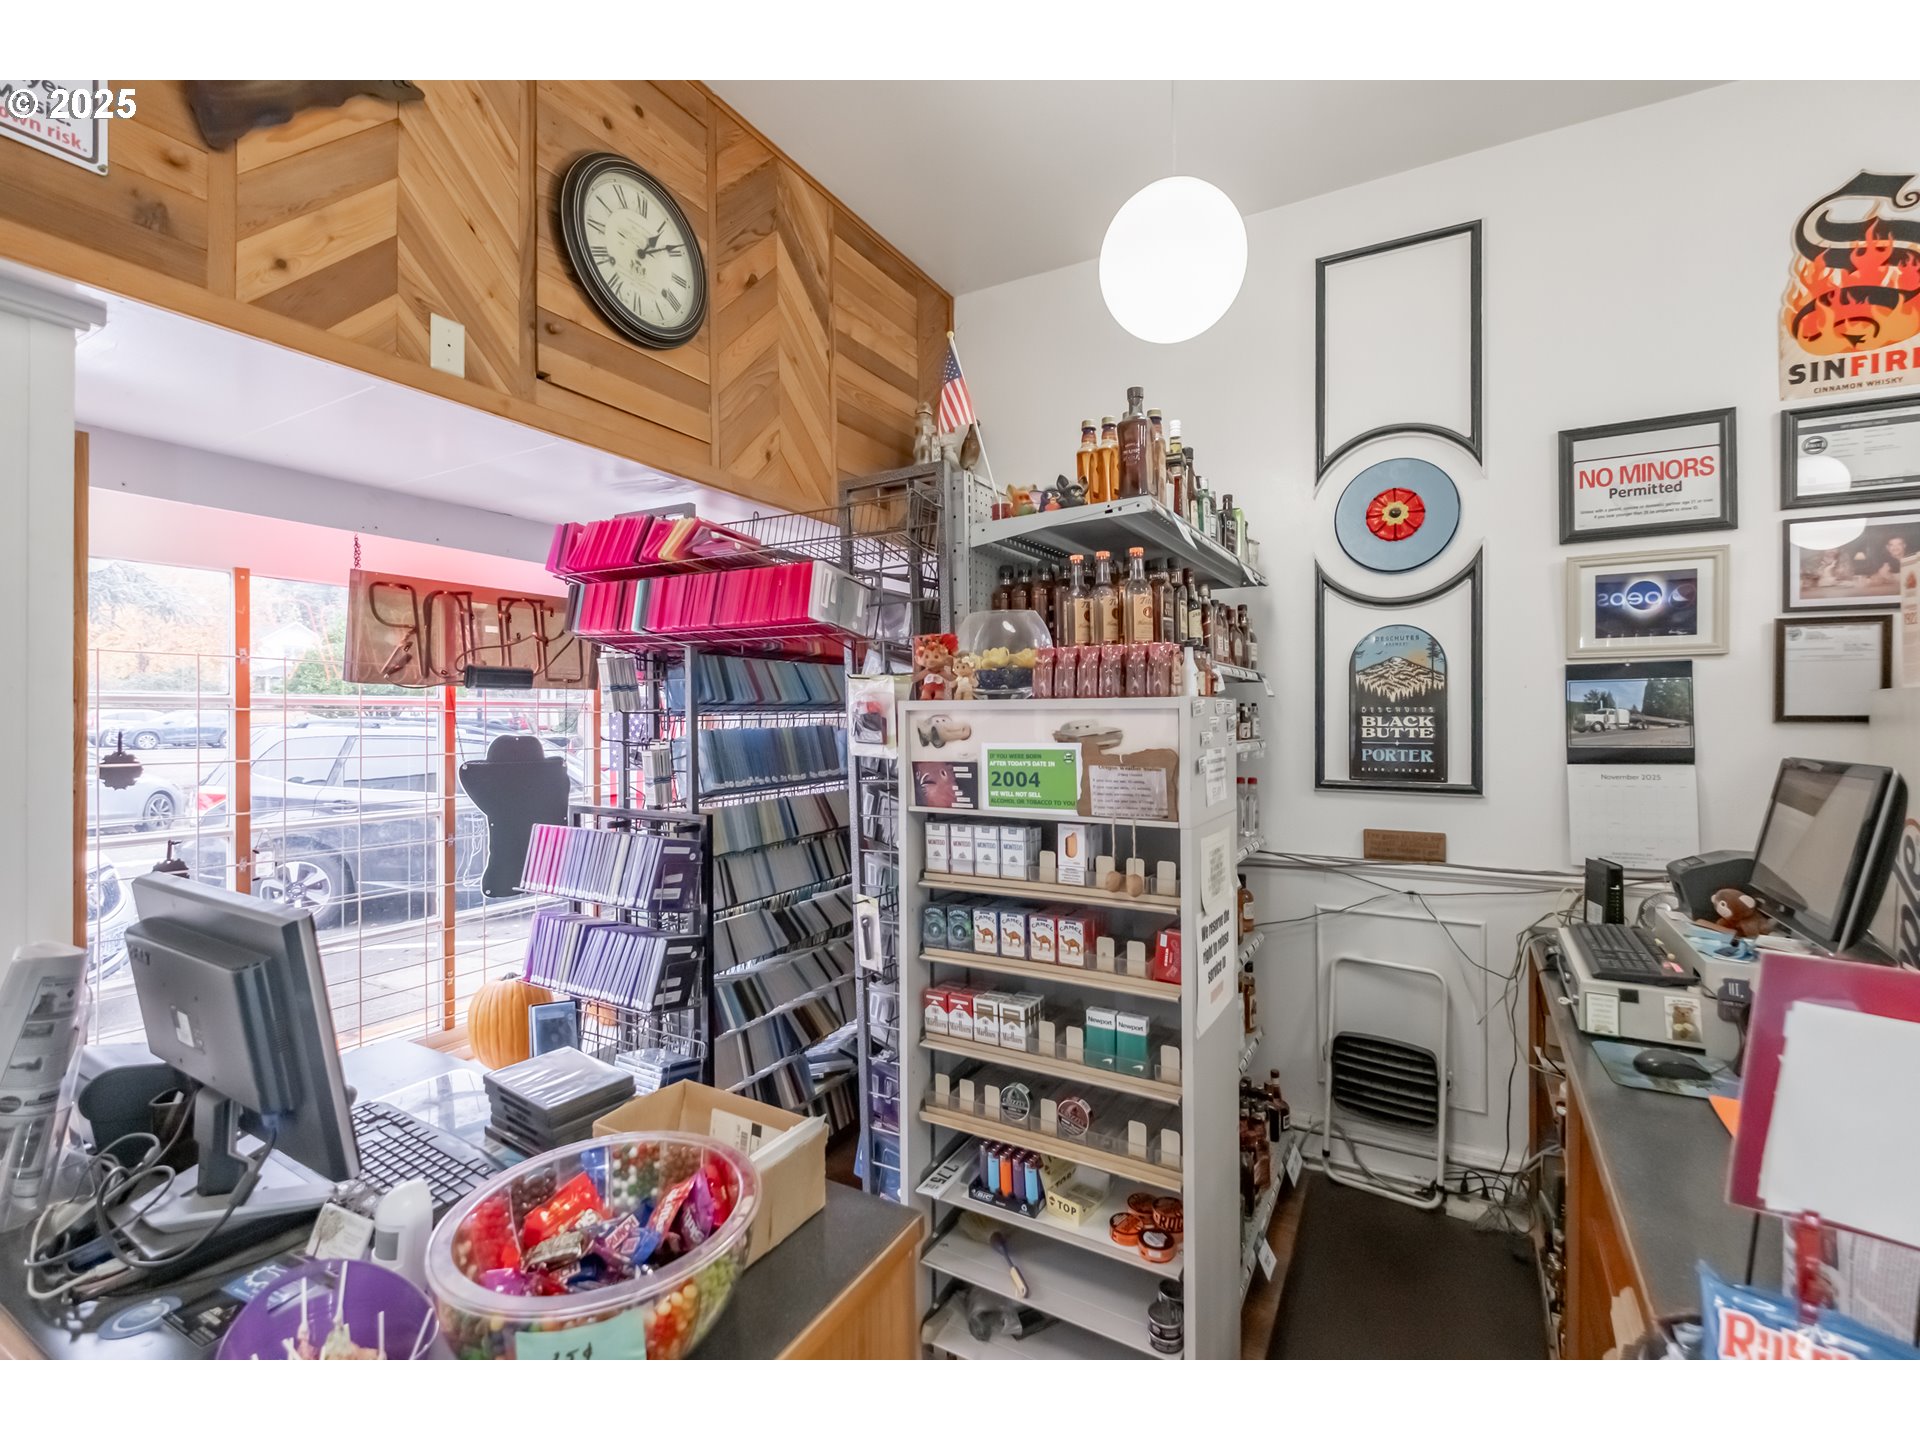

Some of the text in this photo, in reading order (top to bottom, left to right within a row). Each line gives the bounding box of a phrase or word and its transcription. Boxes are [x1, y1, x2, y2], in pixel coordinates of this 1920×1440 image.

[1813, 377, 1904, 394] CINNAMON WHISKY
[1579, 456, 1715, 490] NO MINORS
[1609, 481, 1683, 499] Permitted
[1361, 715, 1434, 727] BLACK
[1361, 728, 1434, 739] BUTTE
[1361, 749, 1434, 763] PORTER
[991, 771, 1040, 787] 2004
[975, 913, 996, 925] CAMEL
[1002, 916, 1023, 928] CAMEL
[1209, 914, 1223, 937] reserve
[1031, 922, 1054, 932] CAMEL
[1059, 925, 1082, 935] CAMEL
[925, 1016, 947, 1029] Marlboro
[949, 1019, 972, 1034] Marlboro
[1087, 1015, 1113, 1026] Newport
[1118, 1021, 1144, 1033] Newport
[975, 1026, 996, 1039] Marlboro
[1002, 1031, 1023, 1045] Marlboro
[977, 1191, 992, 1200] BIC
[1057, 1200, 1077, 1215] TOP
